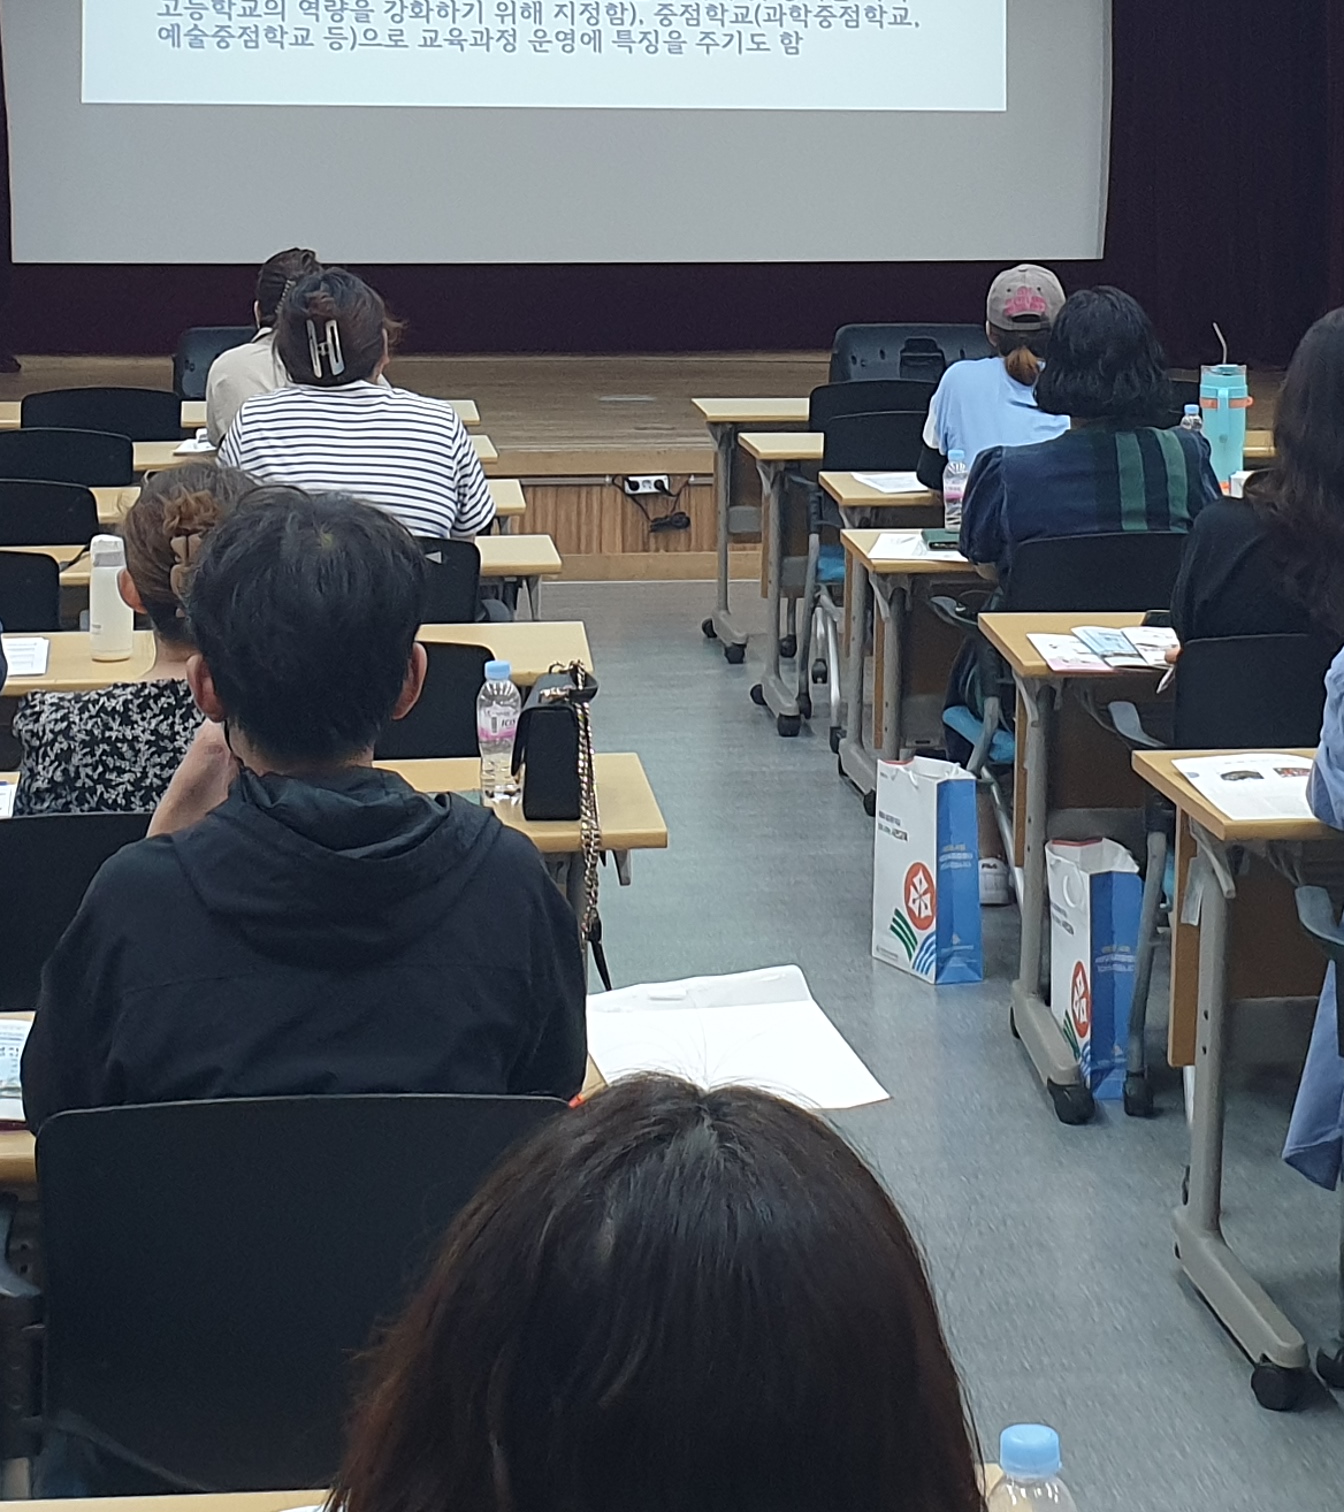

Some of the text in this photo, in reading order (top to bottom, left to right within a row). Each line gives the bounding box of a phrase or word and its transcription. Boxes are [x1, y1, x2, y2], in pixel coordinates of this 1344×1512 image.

[494, 0, 543, 26] 위해
[157, 22, 804, 56] 예술중점학교 등)으로 교육과정 운영에 특징을 주기도 함
